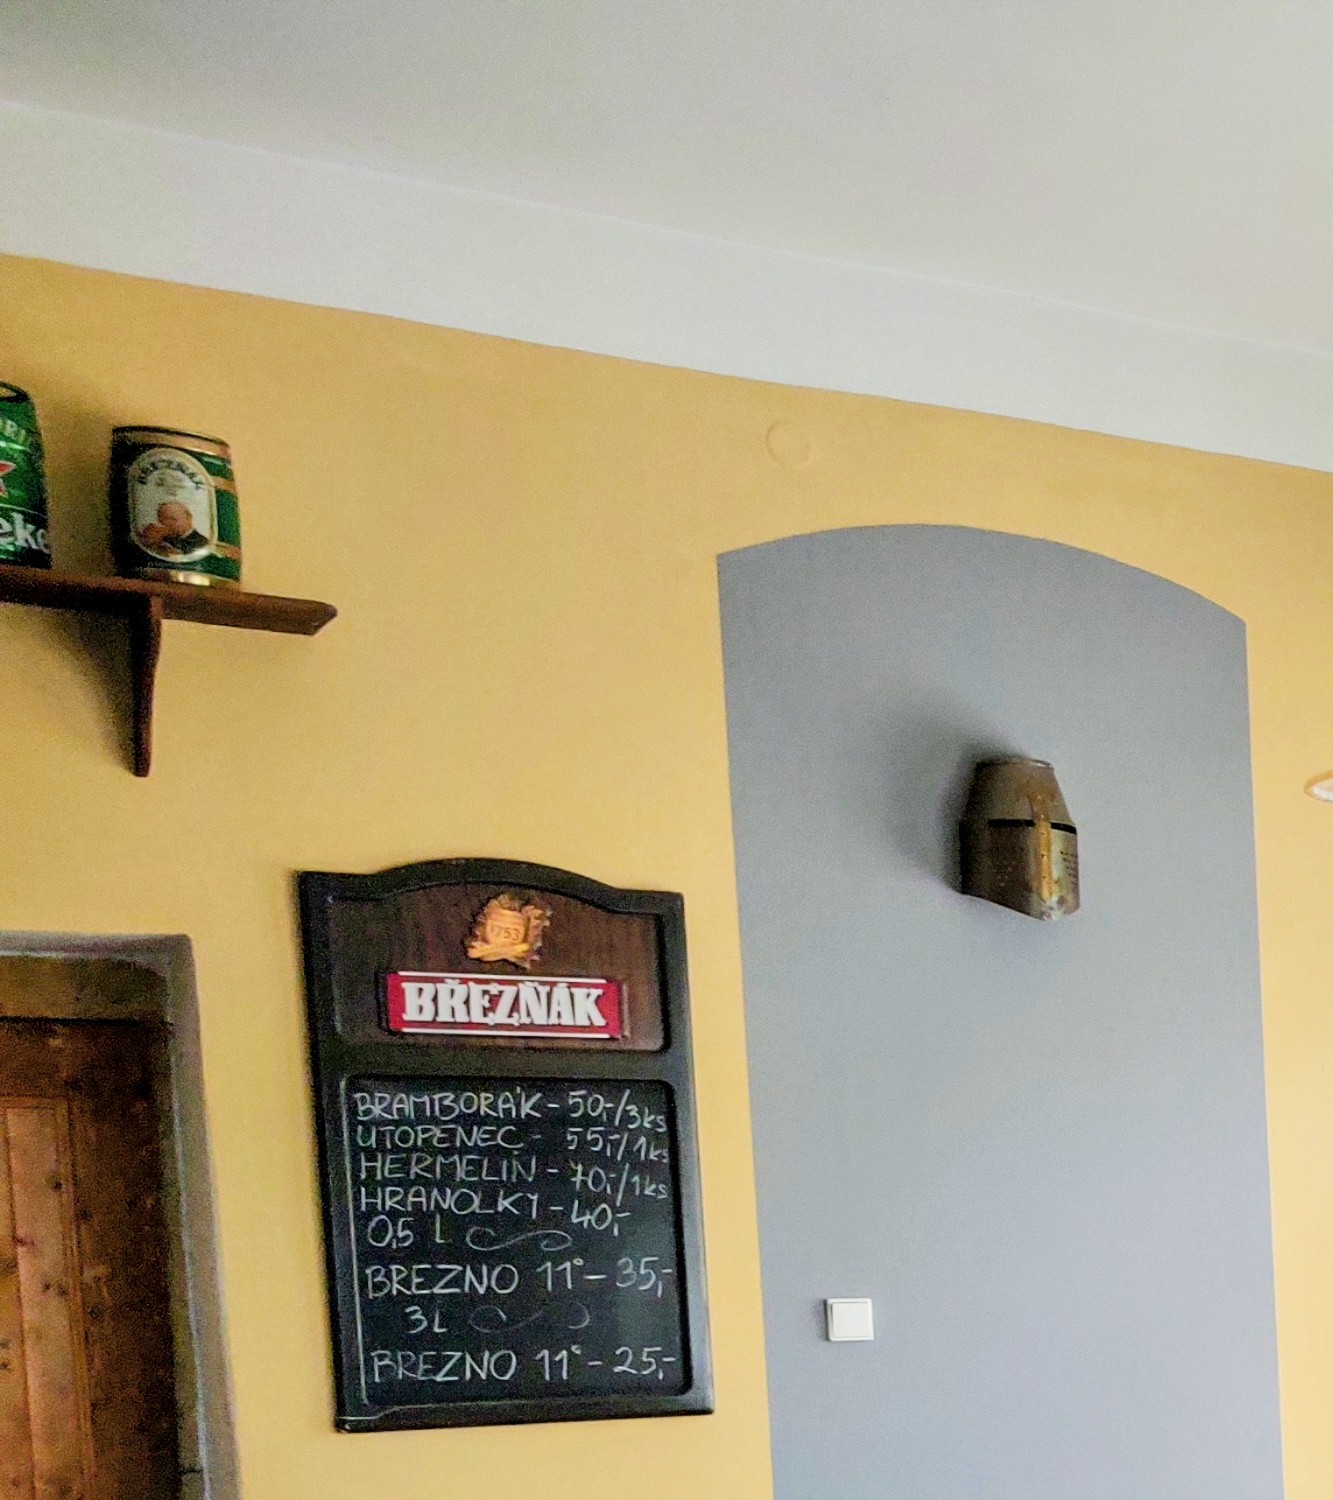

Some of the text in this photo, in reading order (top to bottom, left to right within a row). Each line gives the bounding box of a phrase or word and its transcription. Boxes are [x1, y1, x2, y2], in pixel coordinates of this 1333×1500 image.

[402, 979, 607, 1027] BŘEZŇÁK
[356, 1124, 524, 1149] UTOPENEC
[360, 1186, 538, 1219] HRANOLKY
[368, 1214, 414, 1249] 0,5
[365, 1263, 519, 1299] BREZNO
